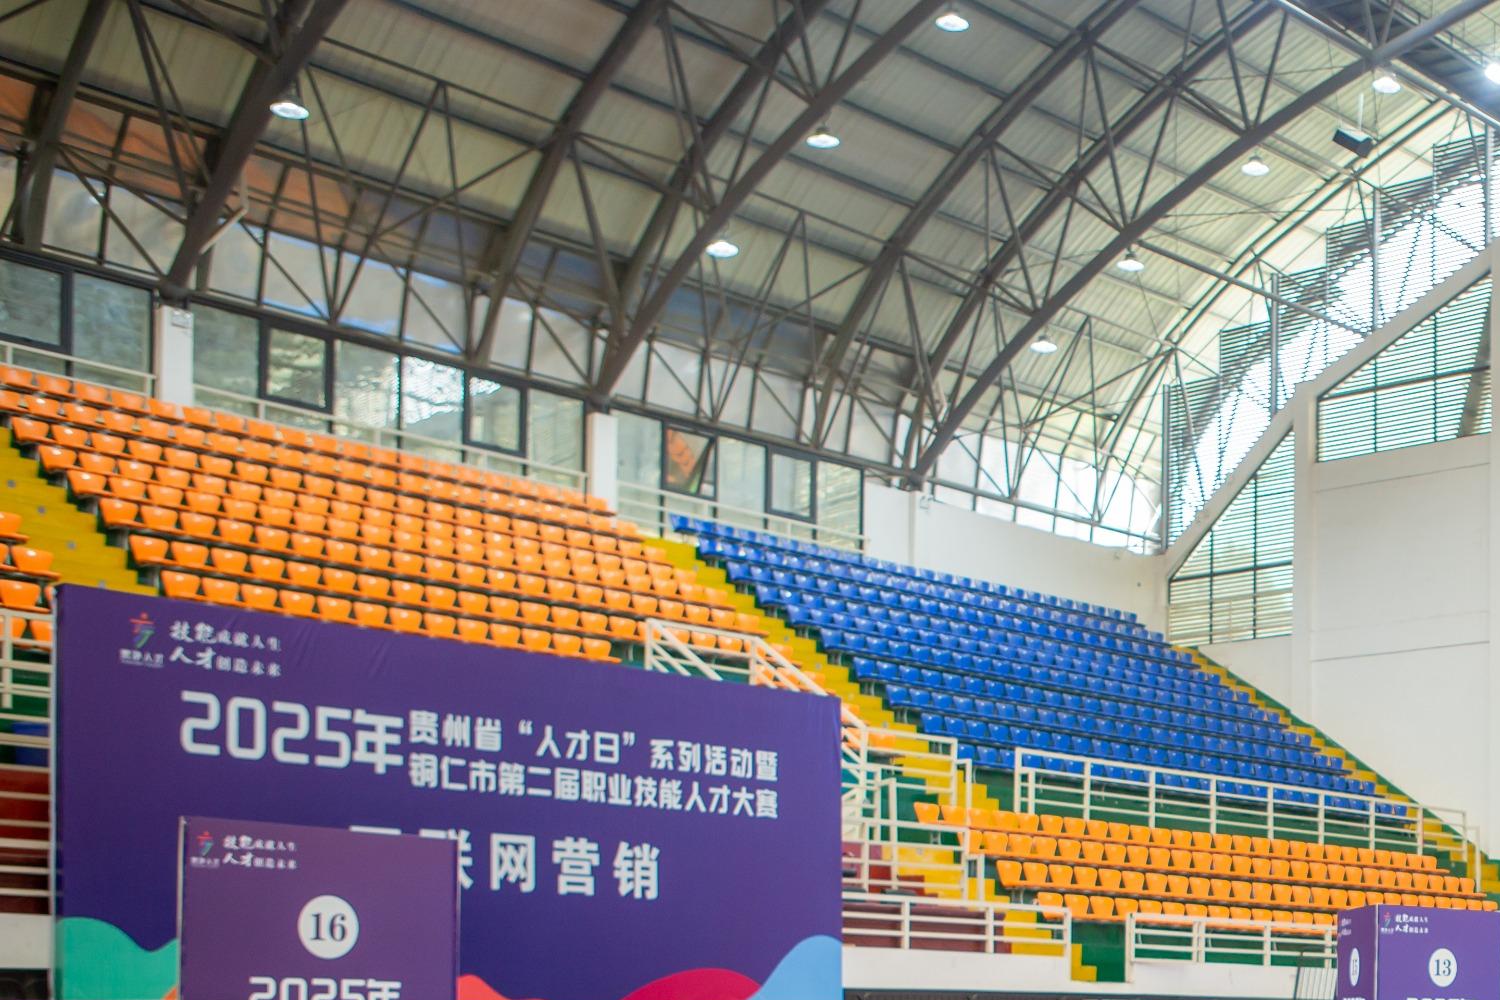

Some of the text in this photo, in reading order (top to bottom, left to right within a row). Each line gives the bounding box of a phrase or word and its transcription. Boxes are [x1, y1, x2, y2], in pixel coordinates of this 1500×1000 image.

[180, 690, 403, 775] 2025年
[408, 752, 778, 819] 铜仁市第二届职业技能人才大赛
[310, 913, 347, 941] 16
[1434, 959, 1452, 977] 13
